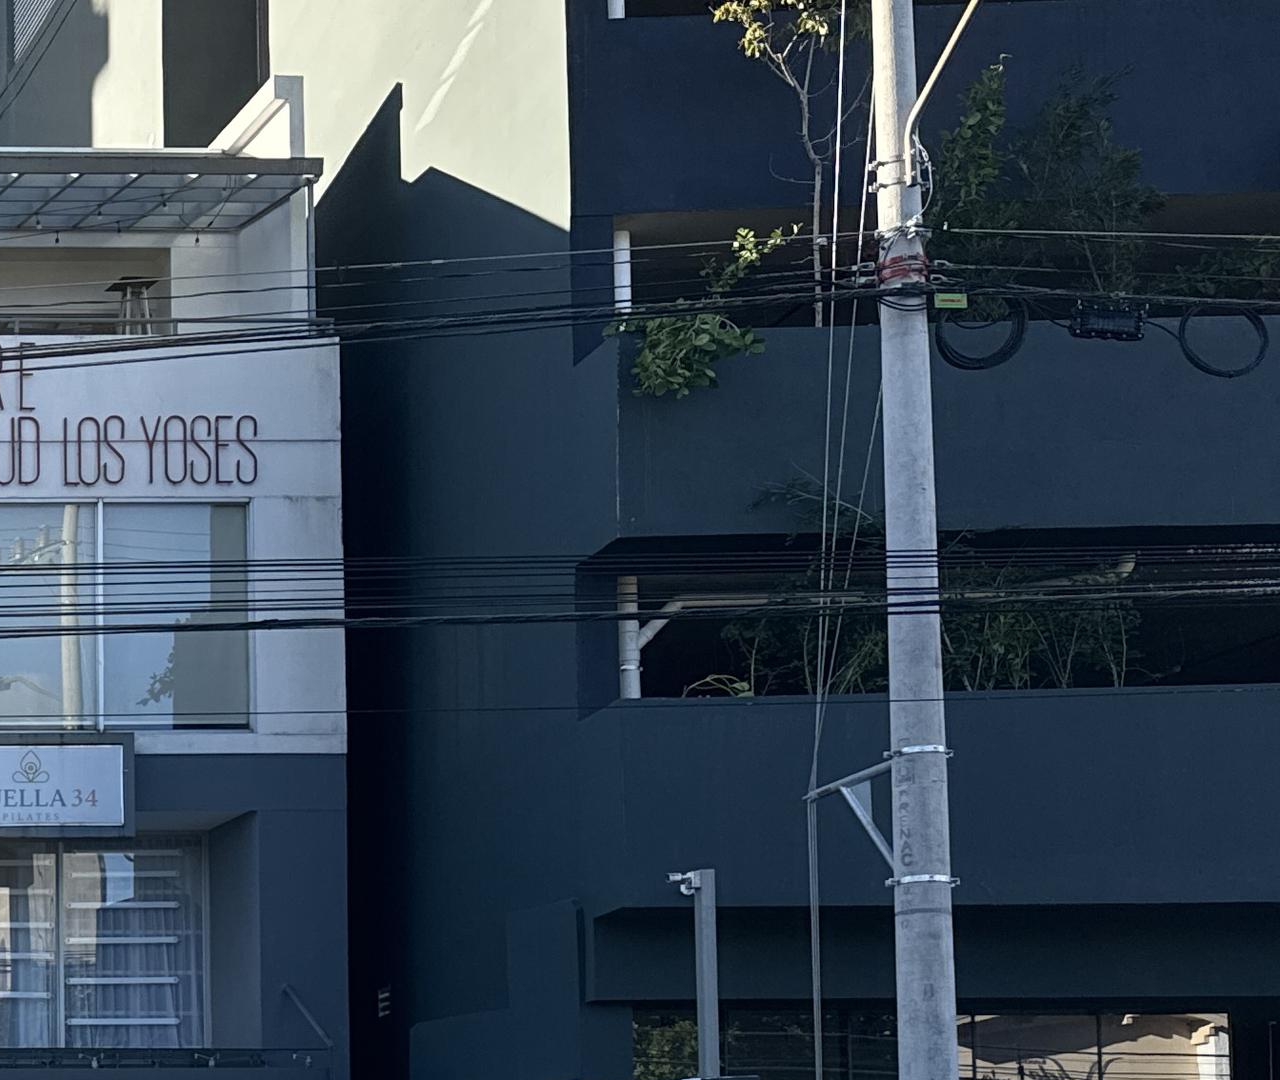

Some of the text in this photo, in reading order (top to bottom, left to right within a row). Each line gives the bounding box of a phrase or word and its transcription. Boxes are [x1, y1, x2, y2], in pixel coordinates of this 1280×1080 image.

[63, 415, 125, 487] LOS
[140, 415, 258, 485] YOSES
[71, 788, 98, 808] 34
[2, 812, 61, 822] PILATES
